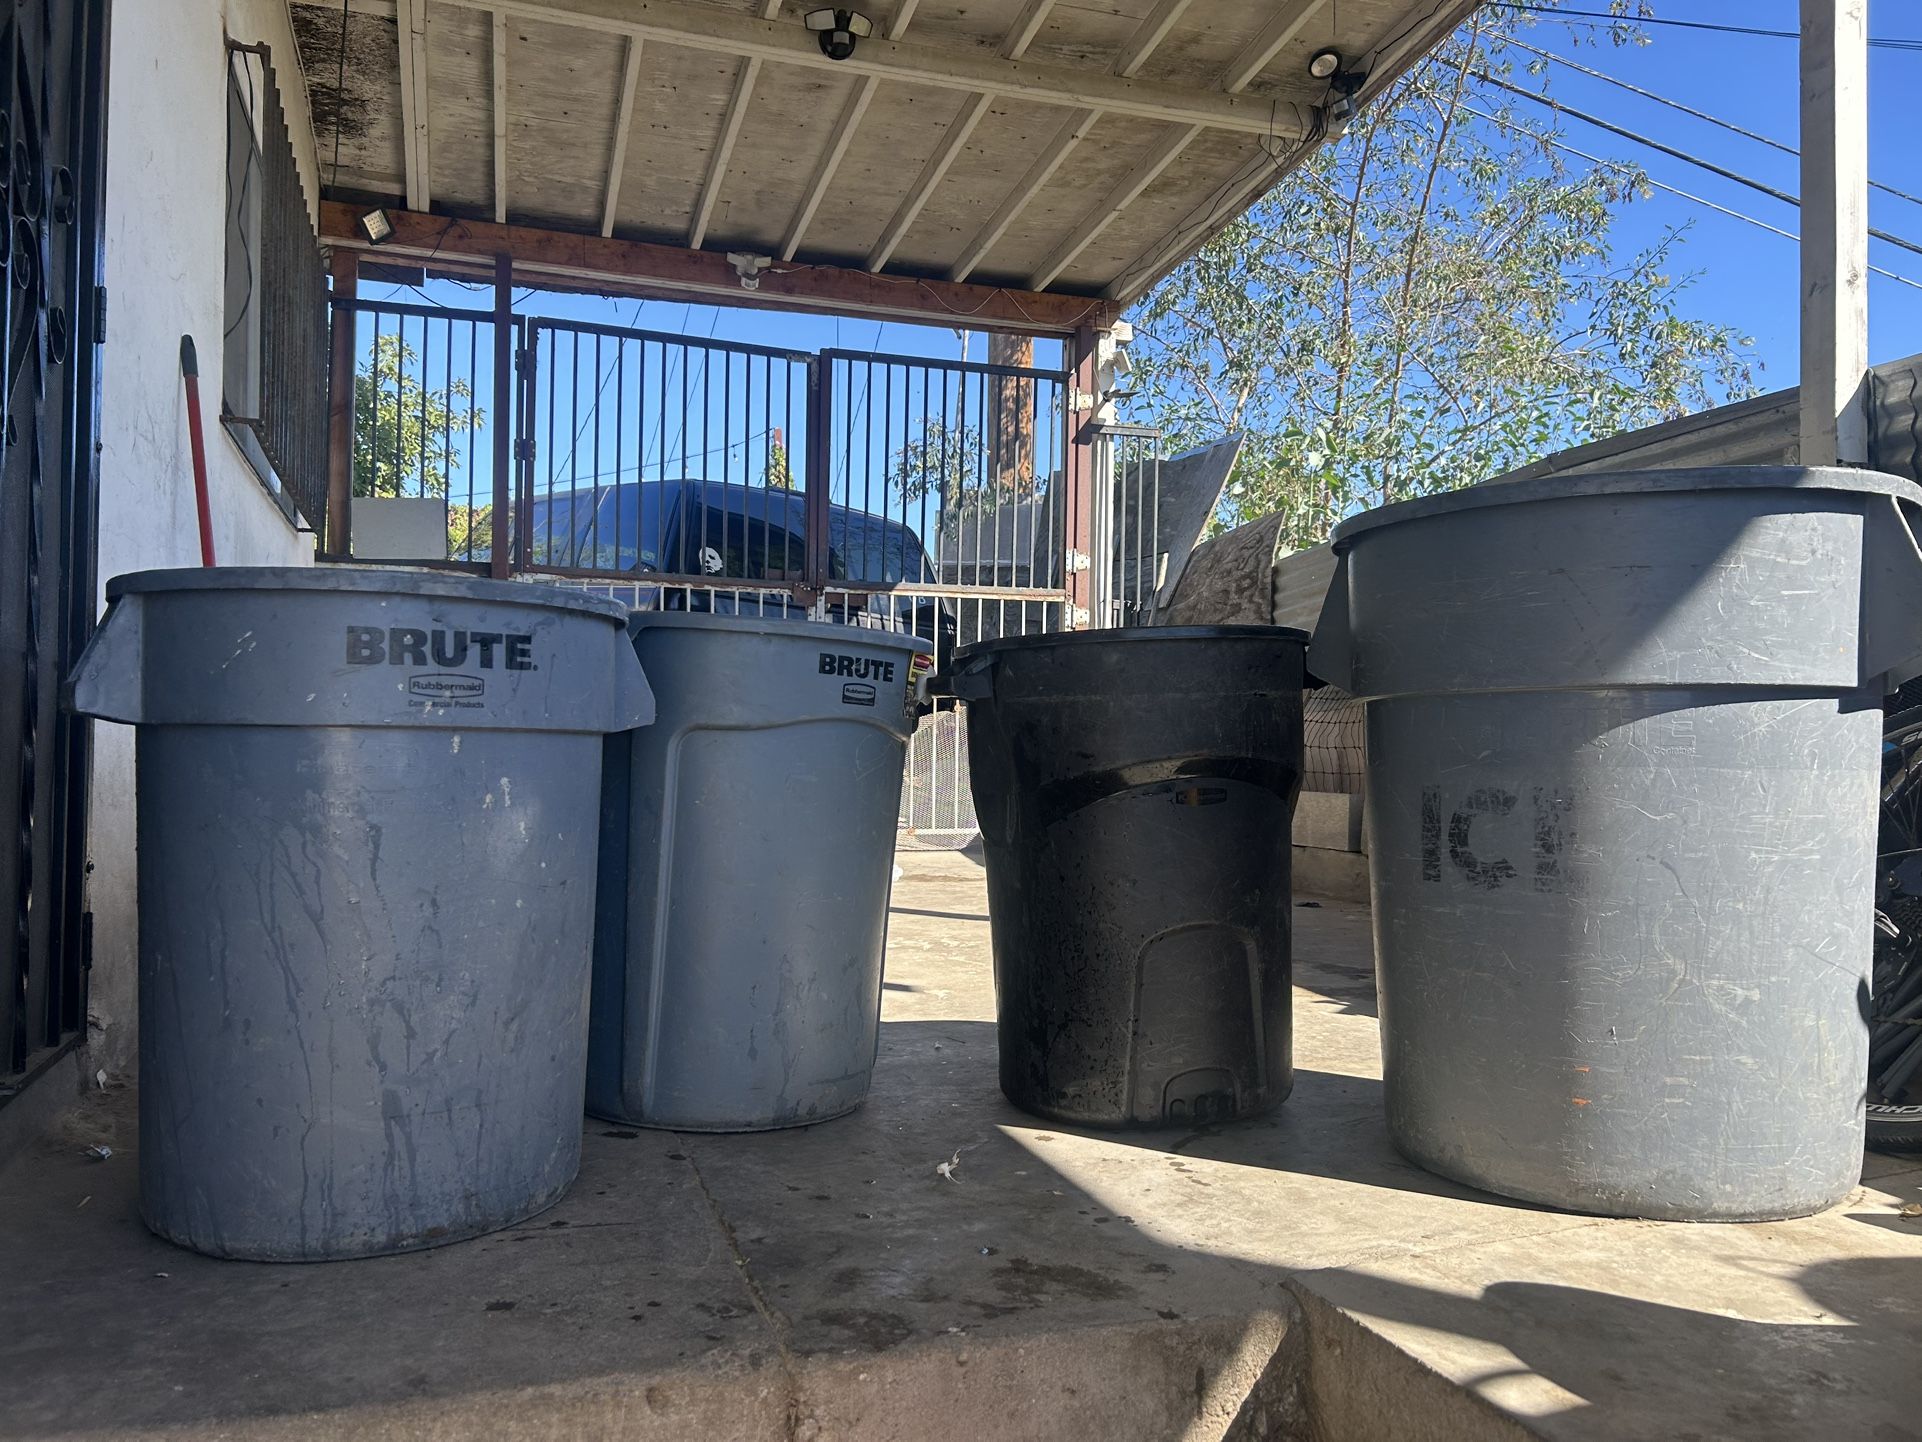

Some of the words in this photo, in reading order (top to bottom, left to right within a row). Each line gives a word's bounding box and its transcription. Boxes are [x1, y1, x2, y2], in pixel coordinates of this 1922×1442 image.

[346, 625, 532, 671] BRUTE
[818, 653, 894, 683] BRUTE
[412, 681, 482, 693] Rubbermaid
[408, 699, 453, 708] Comercial
